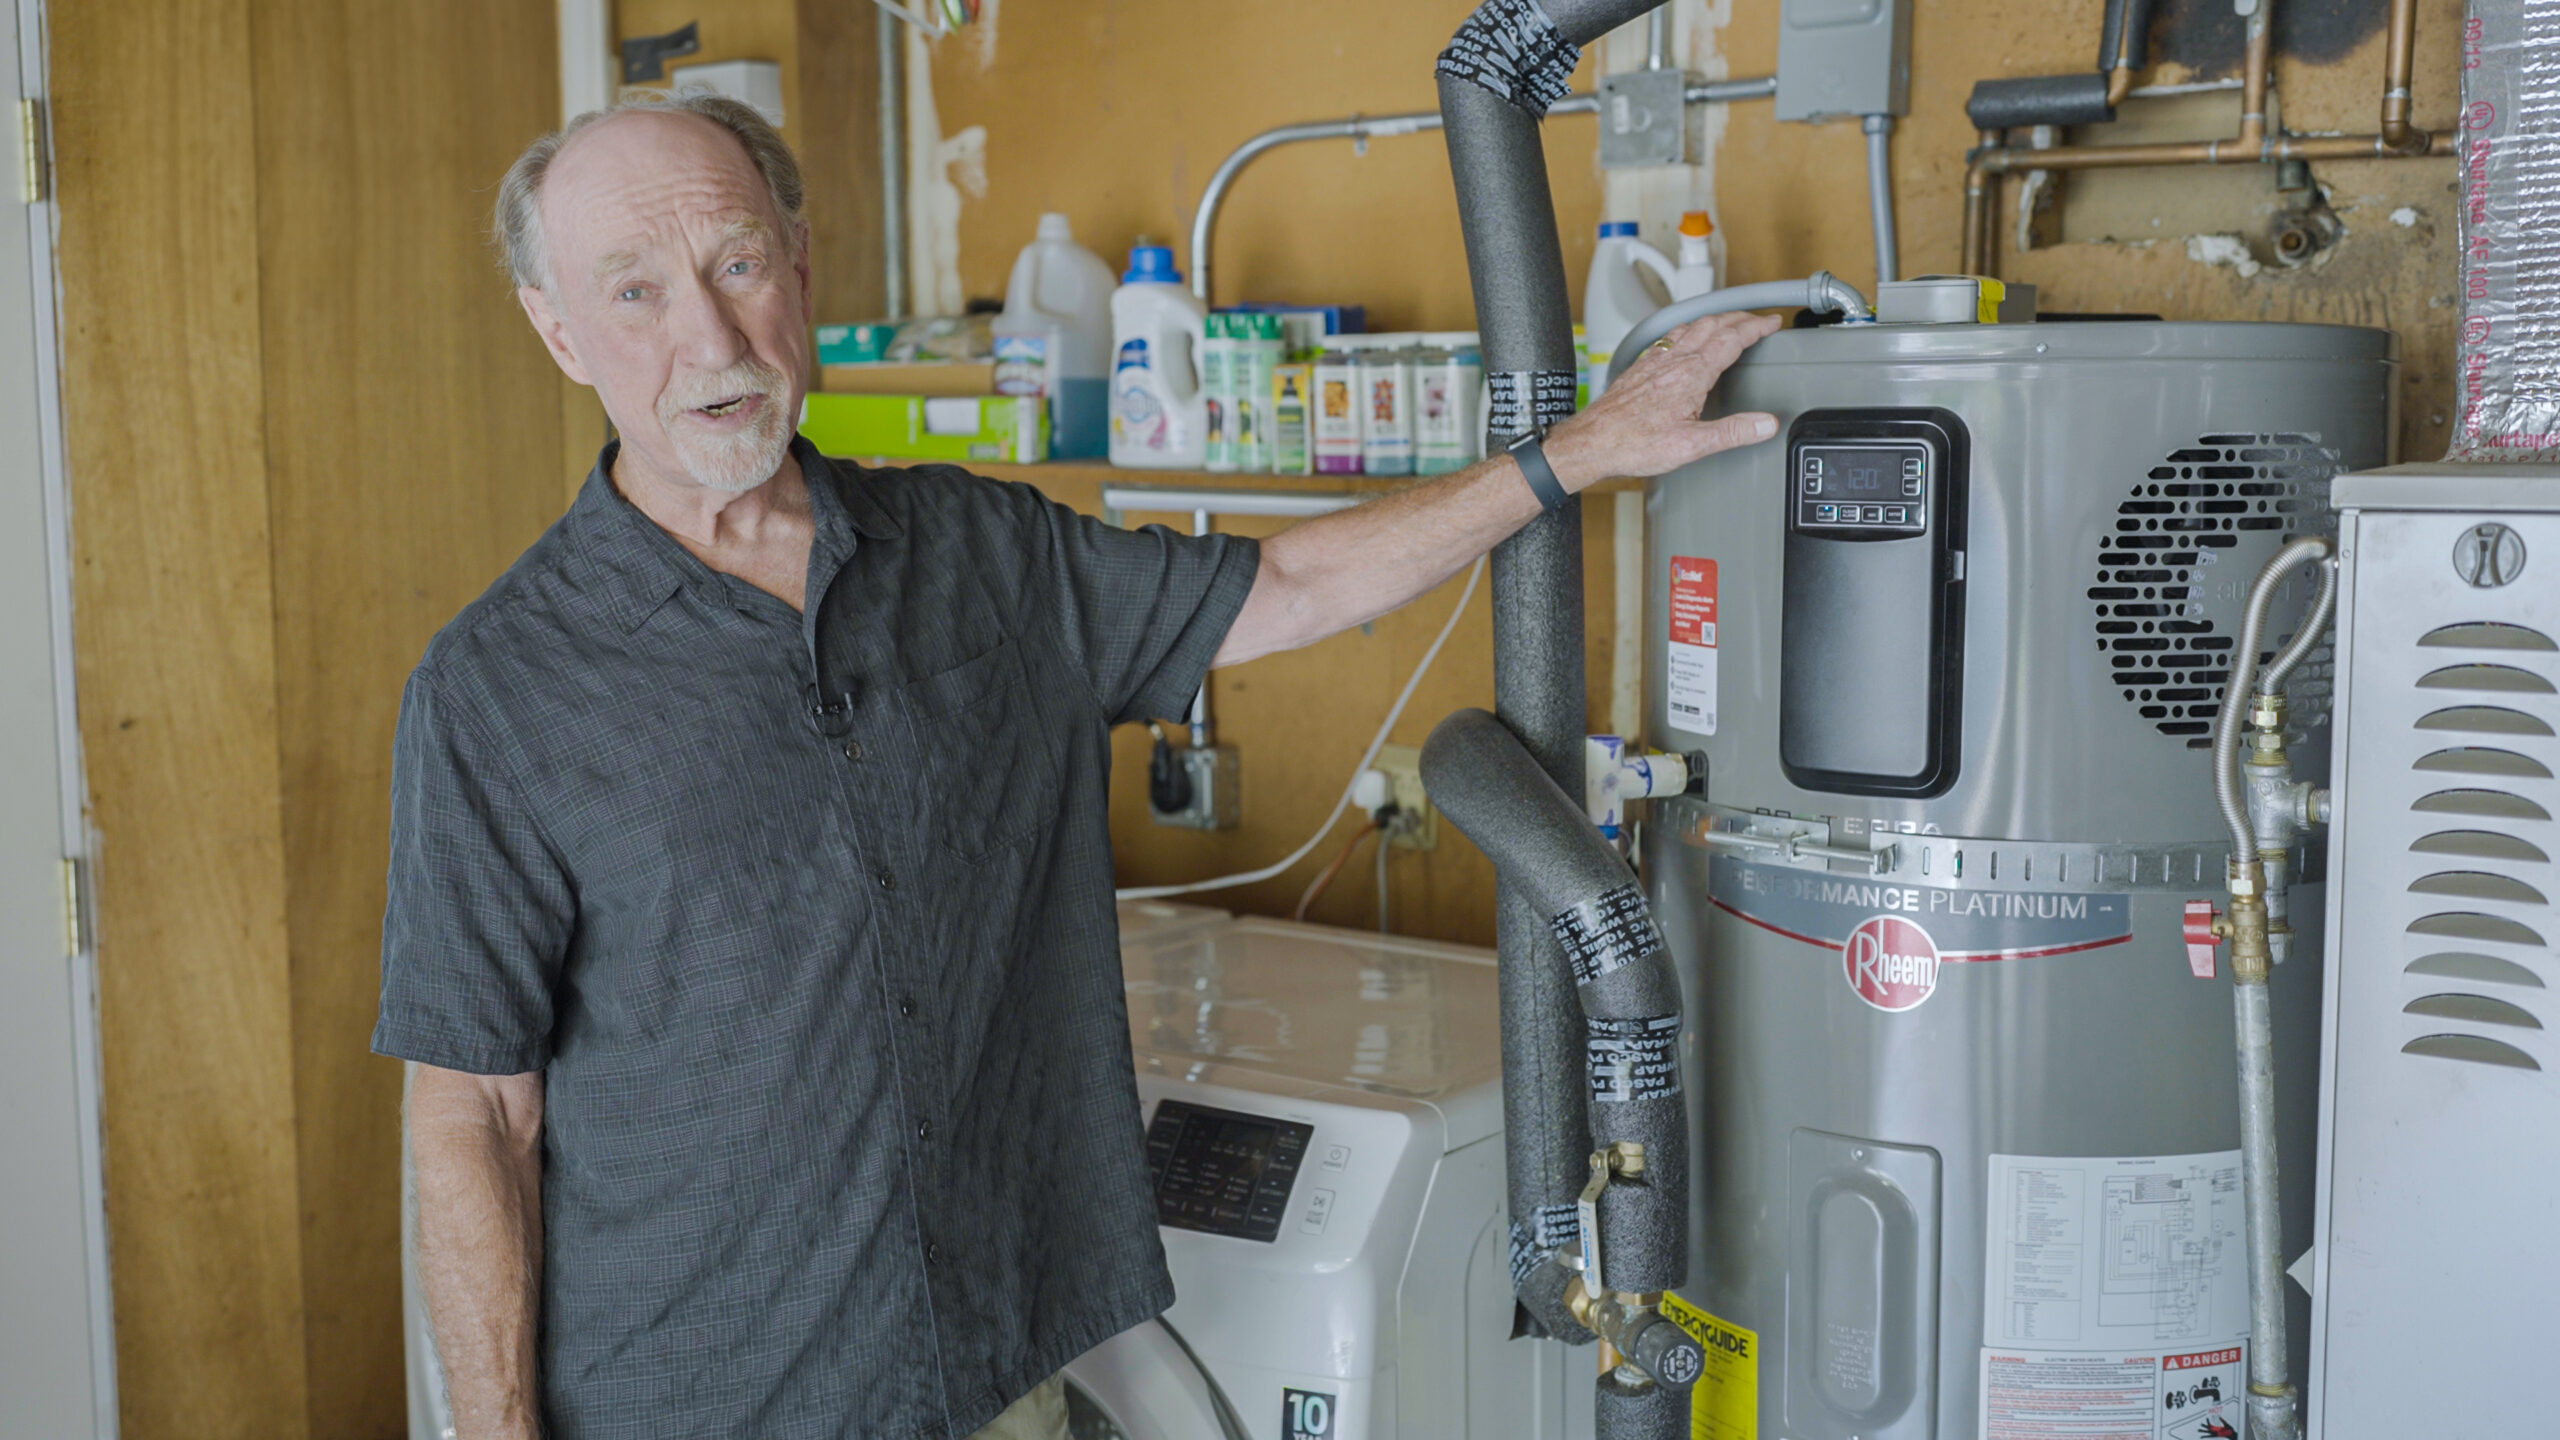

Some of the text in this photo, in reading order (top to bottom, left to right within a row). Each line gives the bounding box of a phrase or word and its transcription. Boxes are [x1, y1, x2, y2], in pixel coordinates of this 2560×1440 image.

[2467, 138, 2492, 225] Shurtape
[2468, 235, 2489, 260] AF
[2467, 267, 2488, 300] 100
[2463, 353, 2488, 438] Shurtape
[2482, 429, 2560, 452] urtape
[1848, 468, 1878, 490] 120
[1929, 890, 2088, 920] PLATINUM
[1855, 918, 1933, 996] Rheem
[1606, 1050, 1663, 1063] PASCO
[2182, 1350, 2237, 1368] DANGER
[1288, 1393, 1329, 1435] 10
